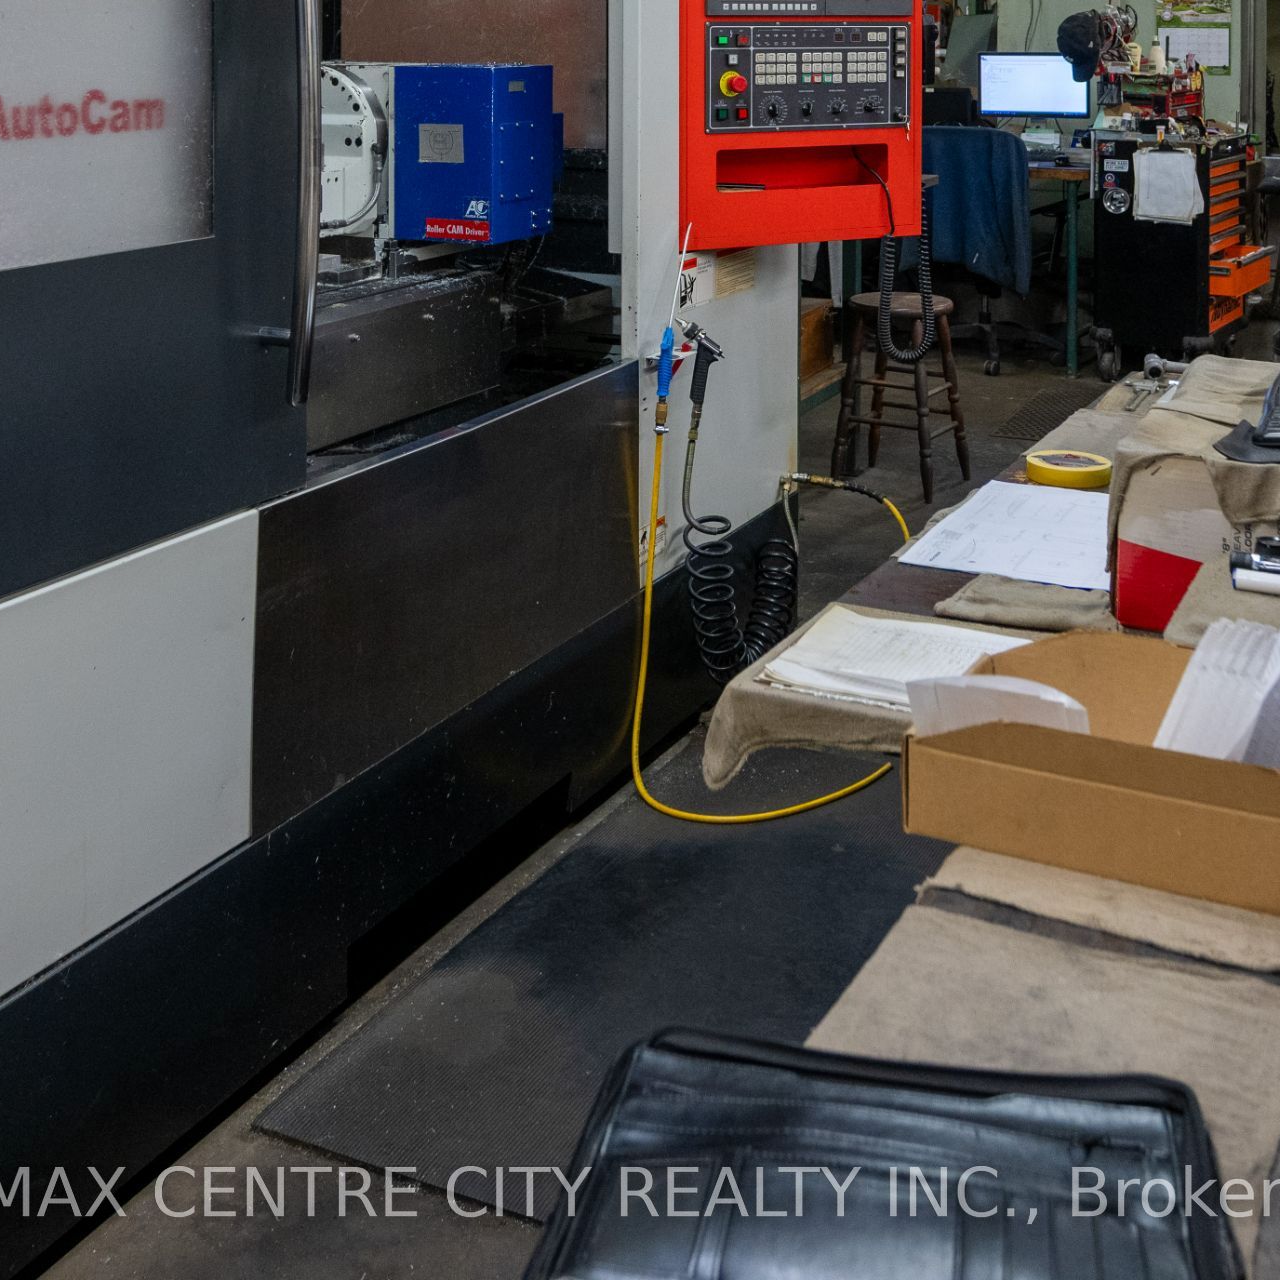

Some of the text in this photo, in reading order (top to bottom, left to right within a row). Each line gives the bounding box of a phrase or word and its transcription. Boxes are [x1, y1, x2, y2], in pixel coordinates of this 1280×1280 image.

[426, 225, 484, 236] Roller CAM Driver
